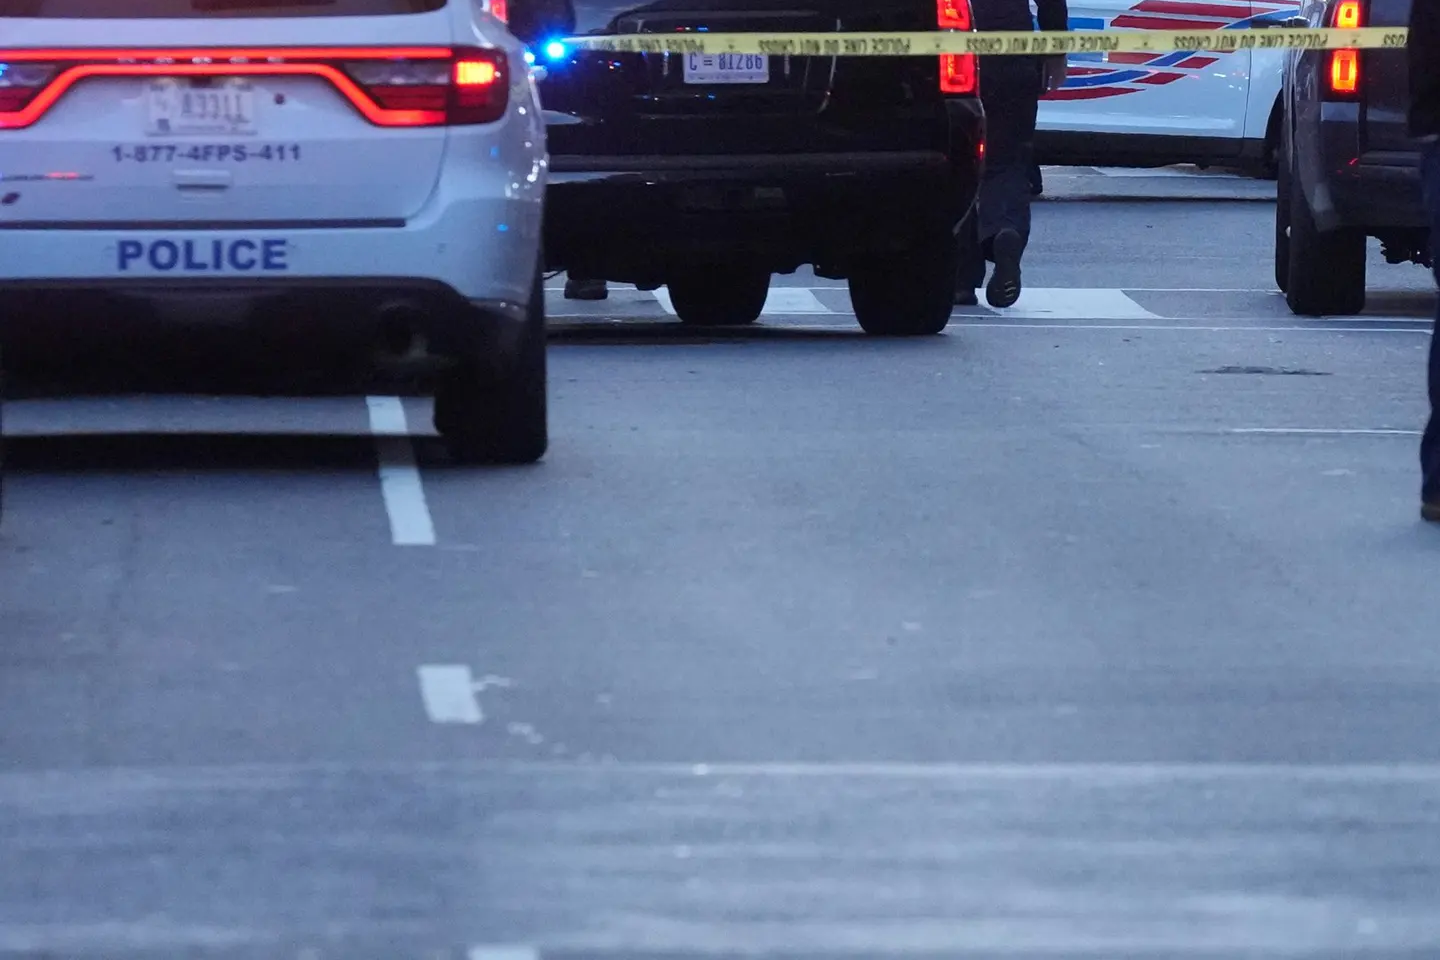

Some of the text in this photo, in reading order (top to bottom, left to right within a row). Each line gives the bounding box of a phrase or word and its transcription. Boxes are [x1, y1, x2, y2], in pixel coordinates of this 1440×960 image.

[758, 38, 911, 53] POLICE LINE DO NOT CROSS
[966, 37, 1120, 52] POLICE LINE DO NOT CROSS
[1174, 34, 1328, 49] POLICE LINE DO NOT CROSS
[111, 144, 301, 164] 1-877-4FPS-411
[117, 239, 288, 271] POLICE
